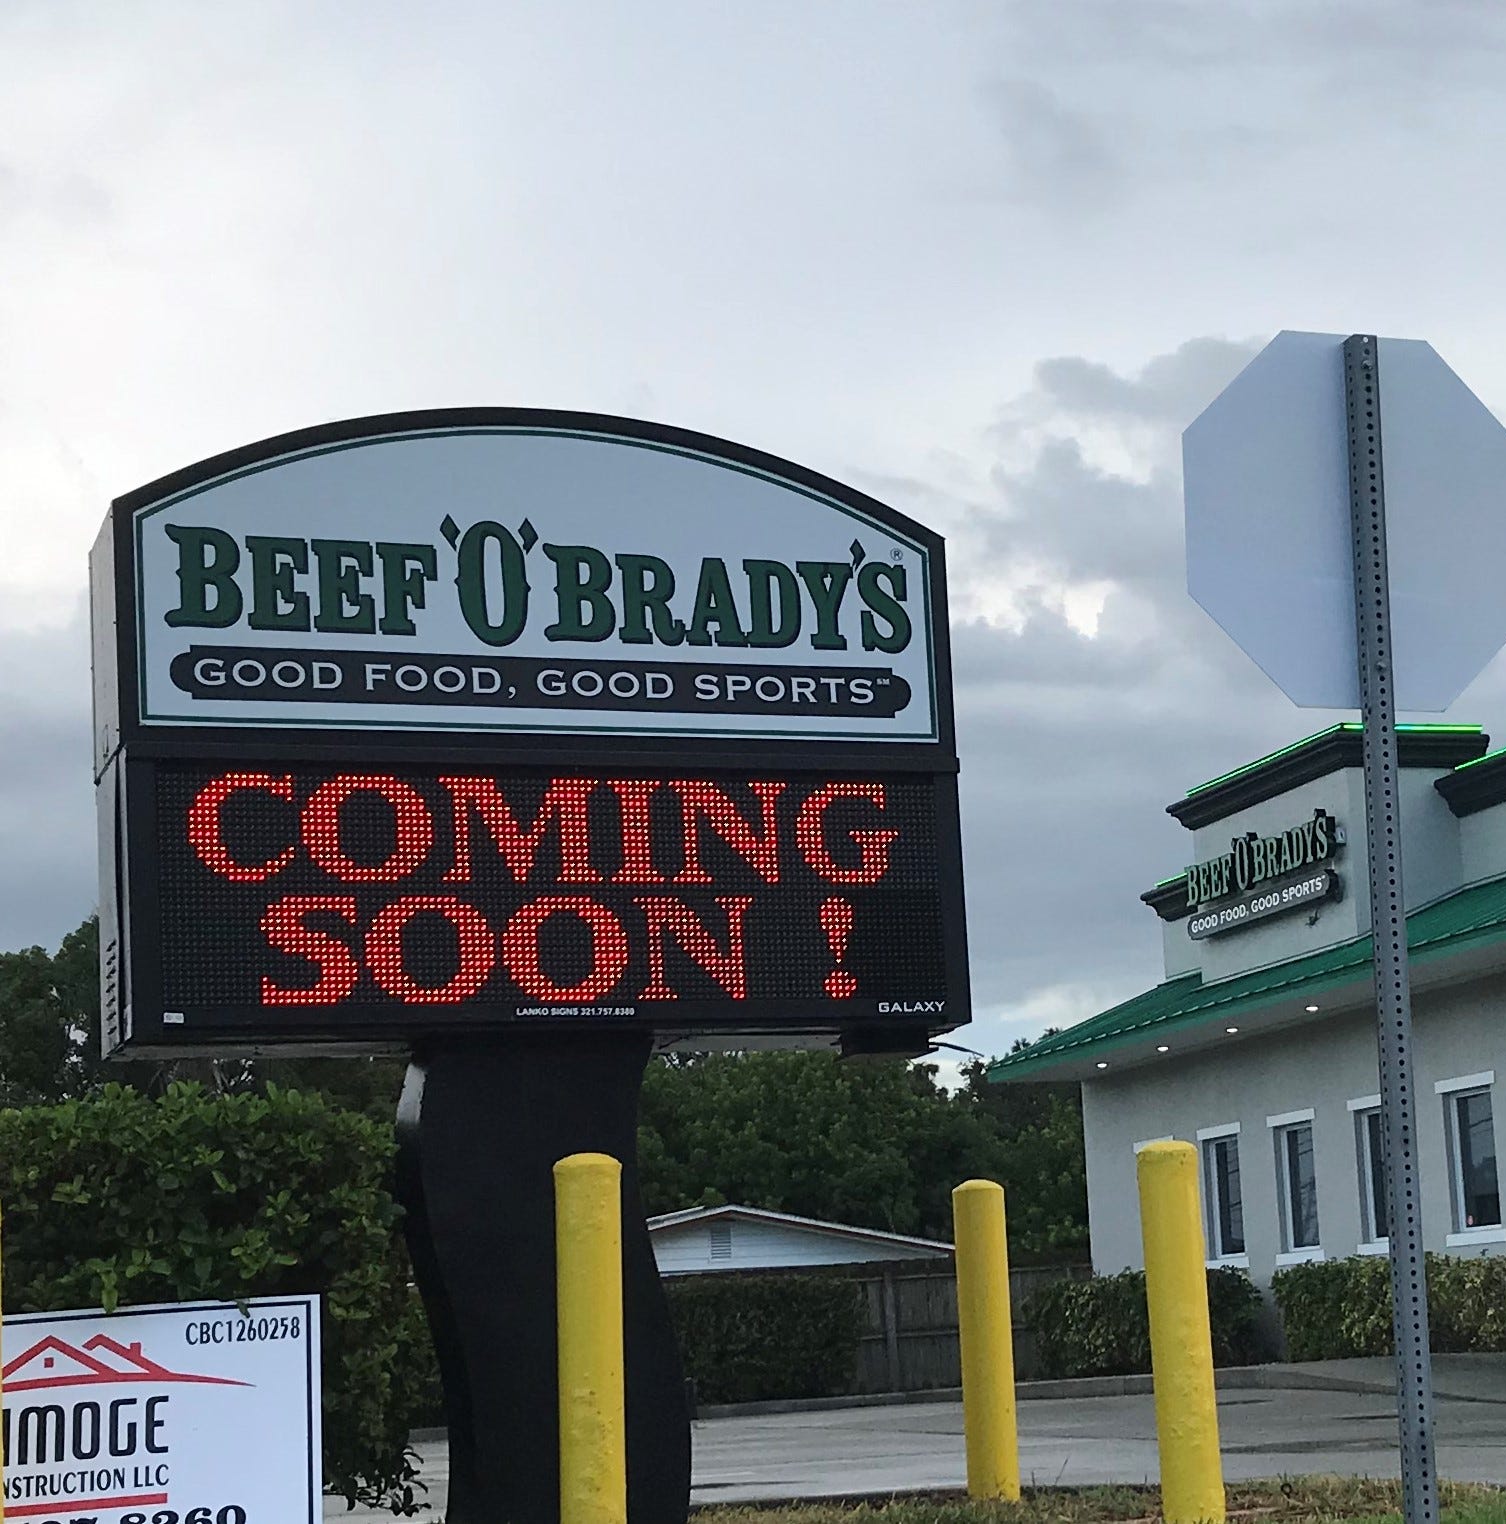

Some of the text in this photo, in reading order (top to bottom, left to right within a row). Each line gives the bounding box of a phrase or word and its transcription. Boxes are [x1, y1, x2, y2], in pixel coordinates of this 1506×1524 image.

[164, 523, 438, 636] BEEF
[542, 538, 912, 654] BRADY'S
[193, 658, 343, 689] GOOD
[365, 663, 516, 699] FOOD,
[536, 669, 674, 699] GOOD
[187, 773, 899, 884] COMING
[1185, 852, 1232, 907] BEEF
[1191, 914, 1218, 933] GOOD
[1220, 904, 1249, 924] FOOD,
[1251, 893, 1280, 913] GOOD
[260, 896, 753, 1004] SOON
[551, 1007, 579, 1016] SIGNS
[878, 1000, 945, 1013] GALAXY
[185, 1316, 301, 1346] CBC1260258
[133, 1464, 169, 1488] LLC
